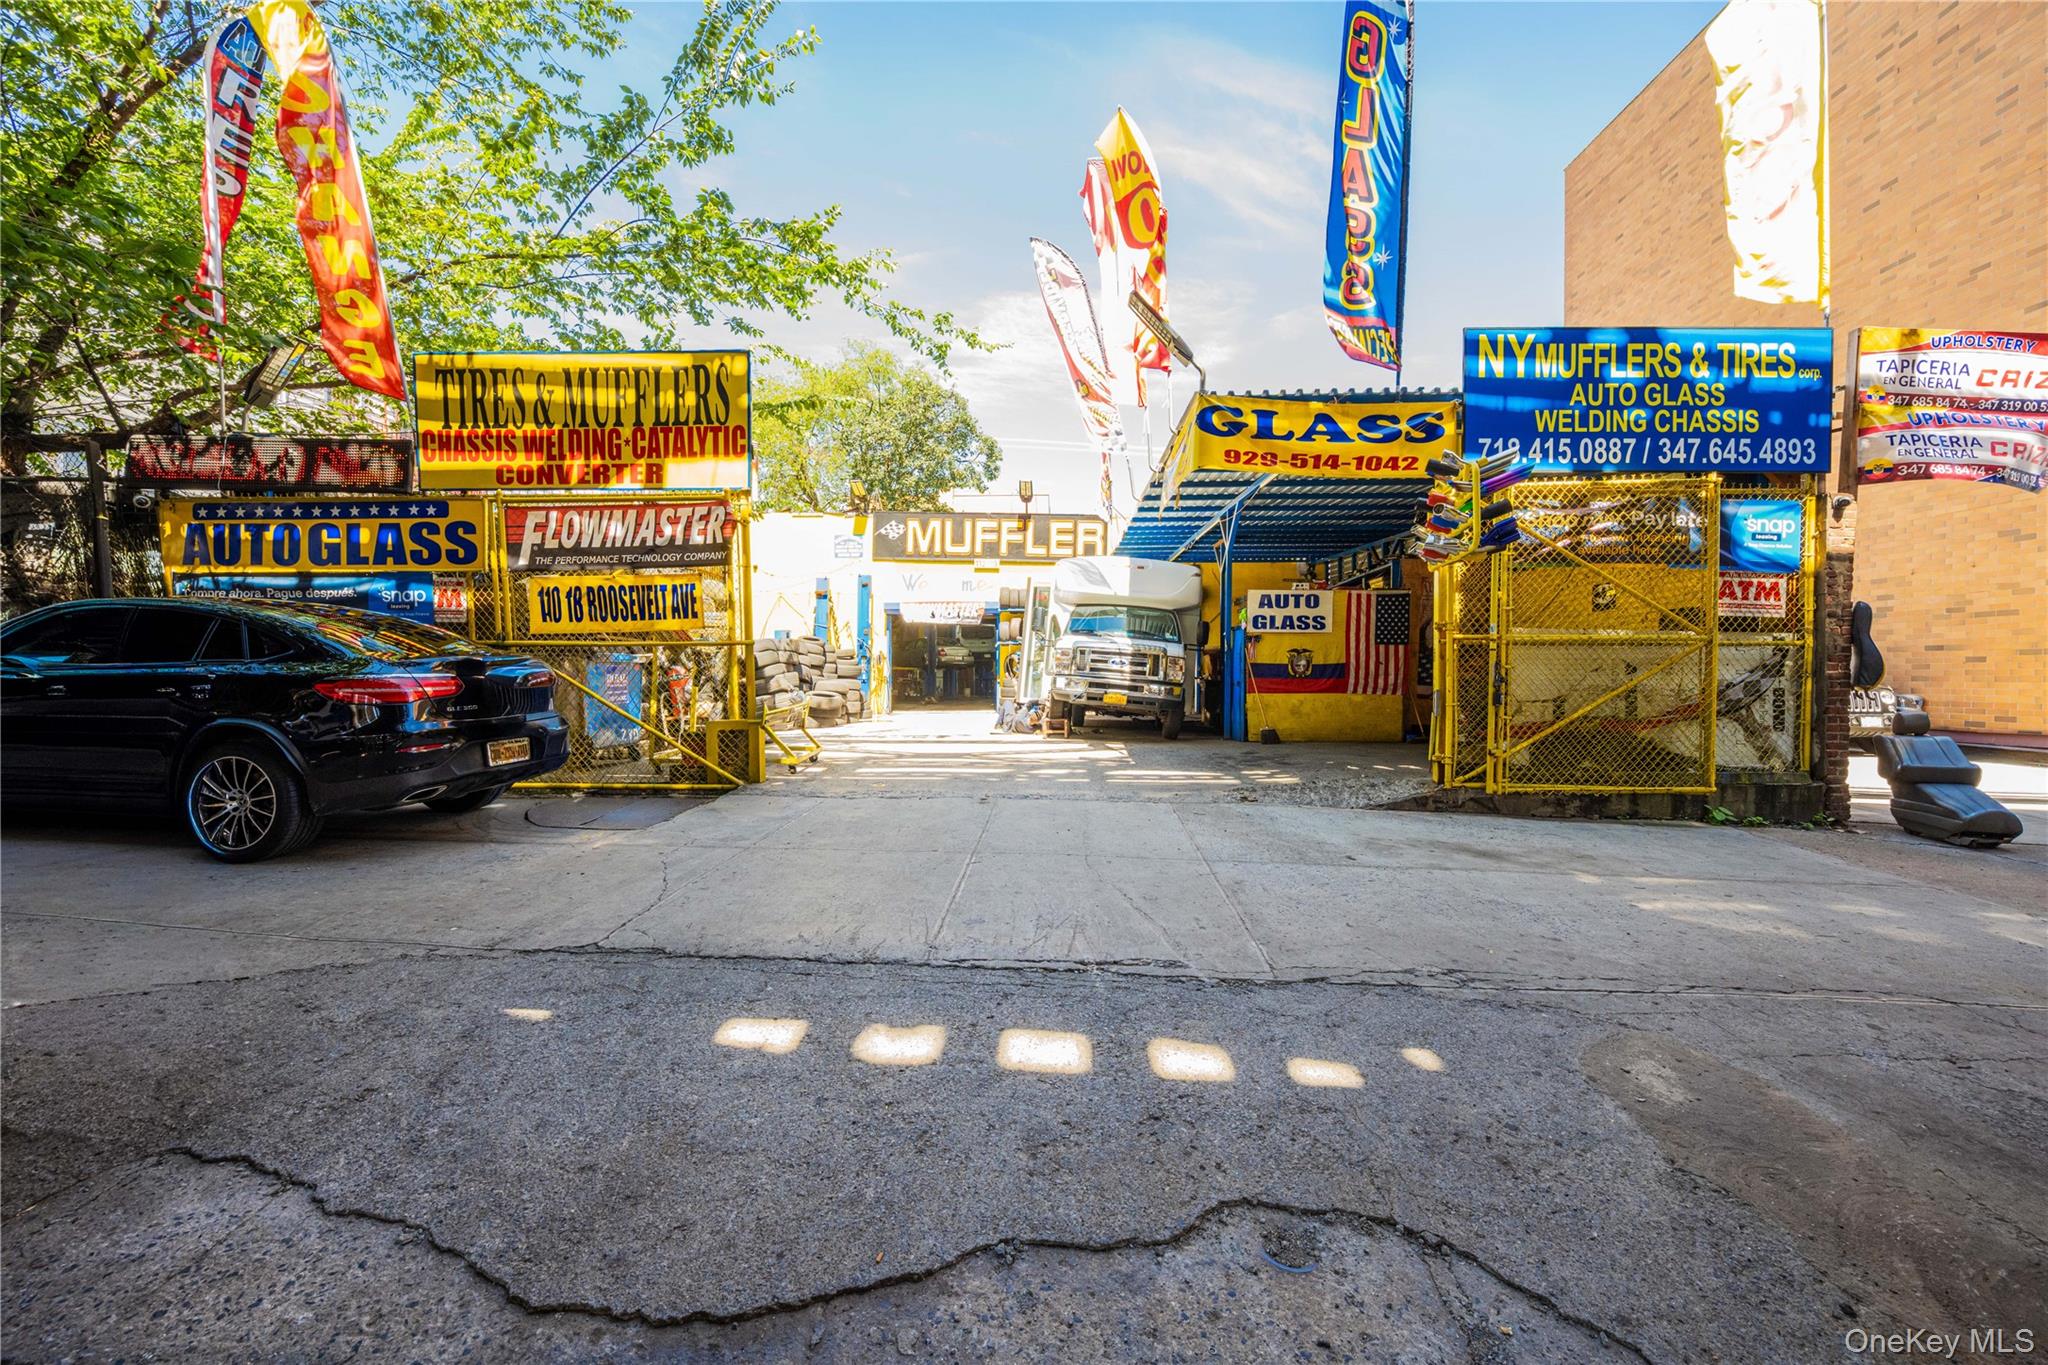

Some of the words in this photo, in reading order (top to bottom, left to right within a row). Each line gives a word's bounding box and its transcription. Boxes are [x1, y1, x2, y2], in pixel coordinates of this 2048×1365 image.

[1931, 335, 2036, 352] UPHOLSTERY
[1536, 343, 1681, 378] MUFFLERS
[1690, 343, 1710, 378] &
[1717, 343, 1796, 378] TIRES
[1798, 367, 1822, 381] corp.
[1876, 359, 1970, 376] TAPICERIA
[1884, 376, 1896, 385] EN
[1899, 375, 1962, 390] GENERAL
[435, 367, 526, 430] TIRES
[533, 372, 555, 427] &
[562, 362, 731, 428] MUFFLERS
[1570, 383, 1639, 406] AUTO
[1644, 383, 1725, 406] GLASS
[1888, 395, 1908, 406] 347
[1912, 396, 1933, 407] 685
[1935, 397, 1950, 408] 84
[1952, 398, 1968, 409] 74
[1978, 400, 1999, 410] 347
[2001, 401, 2021, 411] 319
[2023, 401, 2037, 412] 00
[1196, 405, 1445, 444] GLASS
[1535, 410, 1646, 433] WELDING
[1654, 410, 1759, 433] CHASSIS
[1907, 412, 2045, 431] UPHOLSTERY
[421, 429, 516, 462] CHASSIS
[1643, 438, 1651, 464] /
[1659, 438, 1816, 464] 347.645.4893
[1885, 434, 1983, 448] TAPICERIA
[1224, 449, 1418, 471] 929-514-1042
[1915, 448, 1979, 459] GENERAL
[495, 463, 664, 486] CONVERTER
[1897, 465, 1925, 475] 347
[1929, 464, 1952, 474] 685
[1954, 464, 1969, 474] 84
[1971, 465, 1985, 476] 74
[518, 505, 725, 565] FLOWMASTER
[905, 518, 1105, 556] MUFFLER
[1747, 518, 1796, 539] snap
[535, 556, 553, 565] THE
[555, 555, 619, 565] PERFORMANCE
[622, 553, 682, 563] TECHNOLOGY
[684, 551, 727, 561] COMPANY
[229, 588, 264, 598] ahora.
[267, 588, 302, 600] Pague
[306, 587, 357, 600] después.
[382, 590, 426, 607] snap
[1719, 580, 1782, 601] ATM
[538, 586, 562, 623] 110
[566, 586, 583, 623] 18
[587, 584, 668, 622] ROOSEVELT
[671, 583, 699, 619] AVE
[1258, 594, 1320, 609] AUTO
[1252, 615, 1326, 630] GLASS
